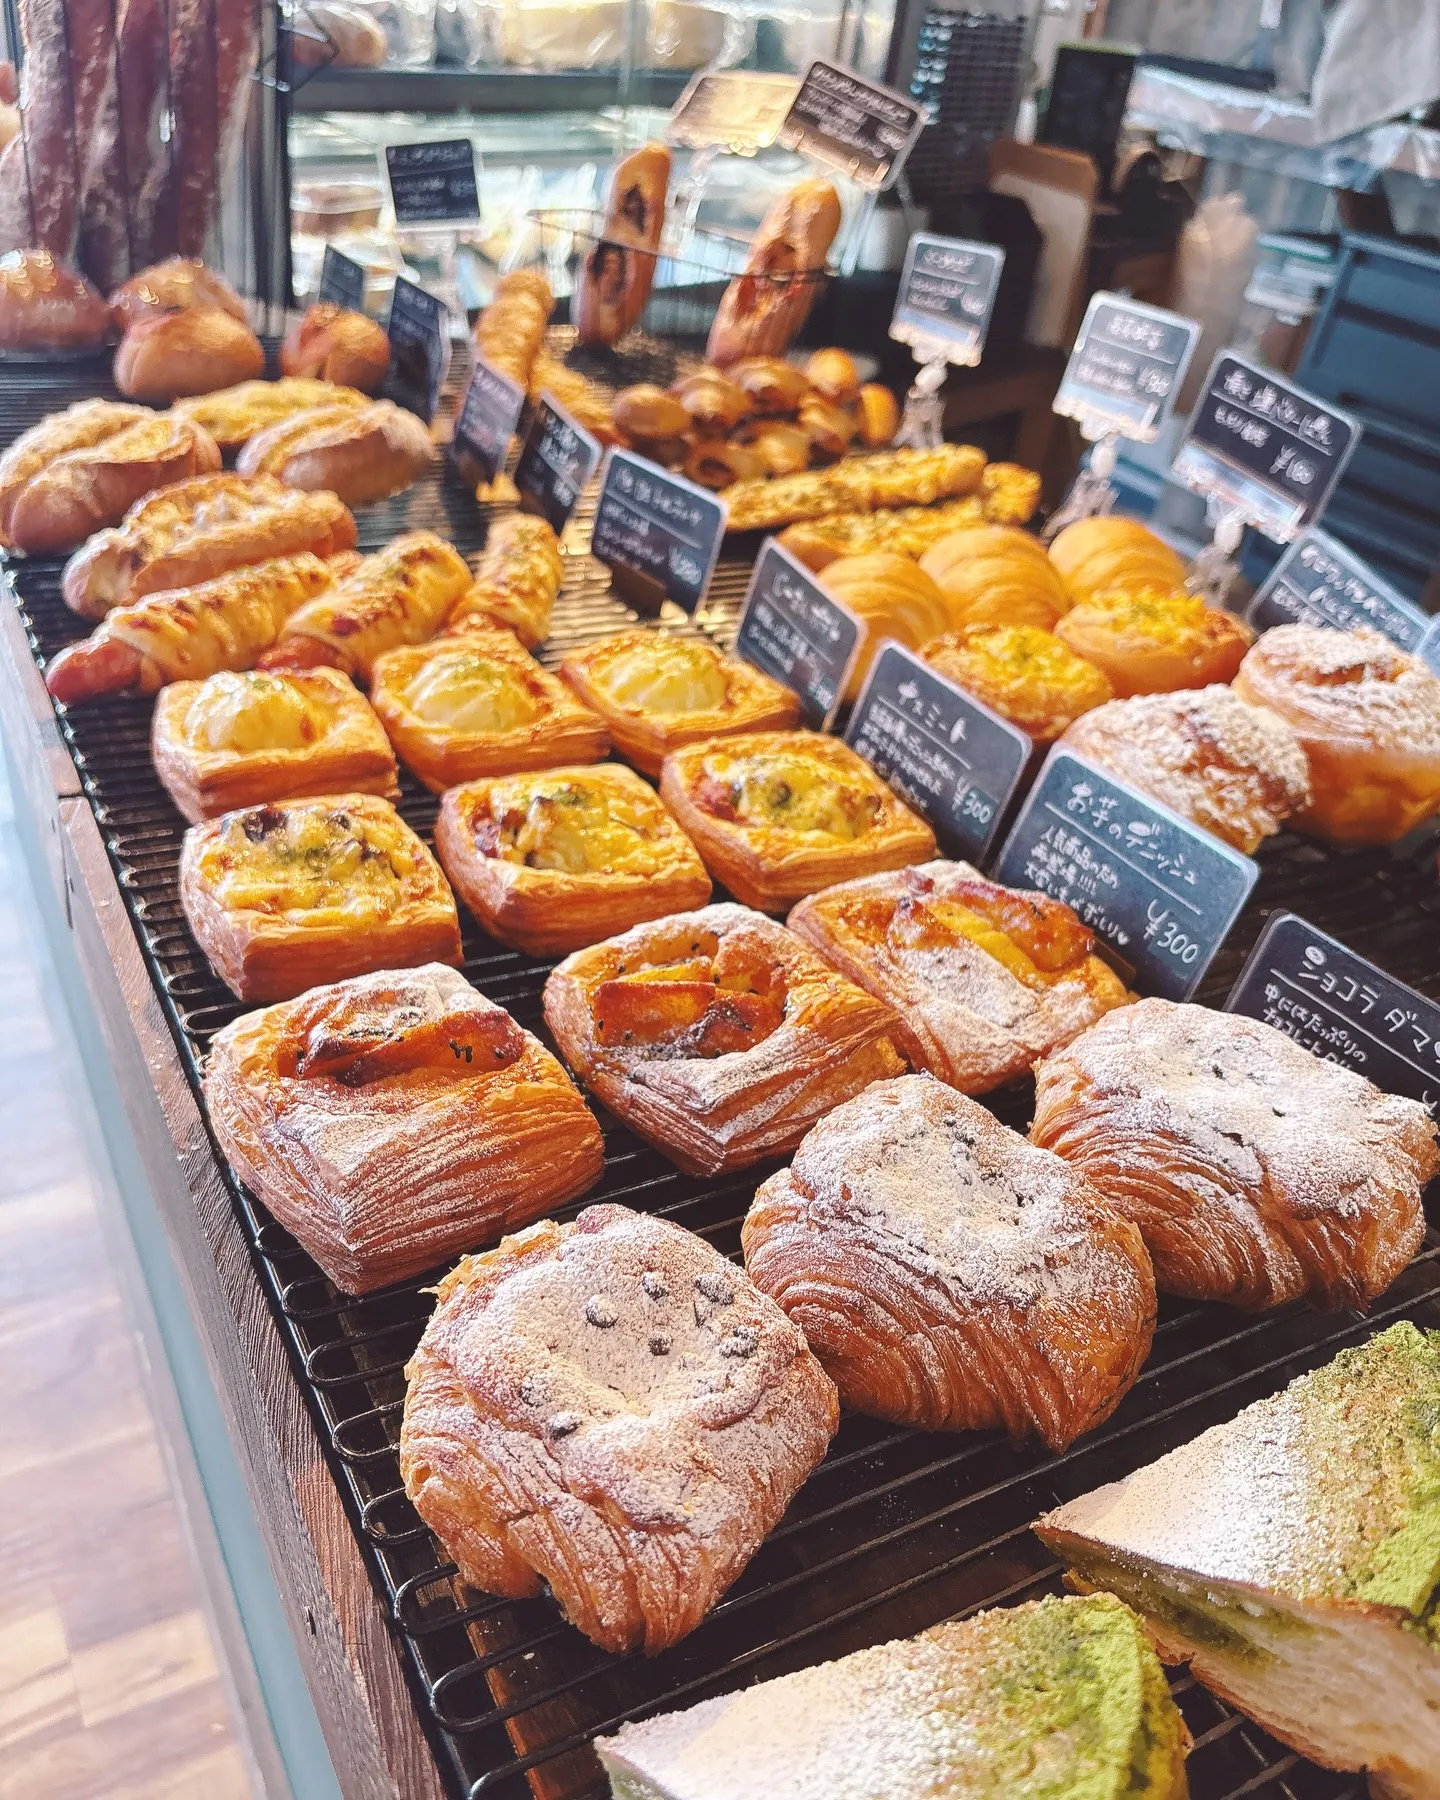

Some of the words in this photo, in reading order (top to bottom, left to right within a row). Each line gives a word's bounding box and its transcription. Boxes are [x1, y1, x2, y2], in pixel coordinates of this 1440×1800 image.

[1066, 781, 1197, 886] お芋のデニッシュ
[1143, 898, 1201, 964] ¥300
[1298, 945, 1380, 1014] ショコラ
[1264, 983, 1368, 1062] 中にはたっぷりの
